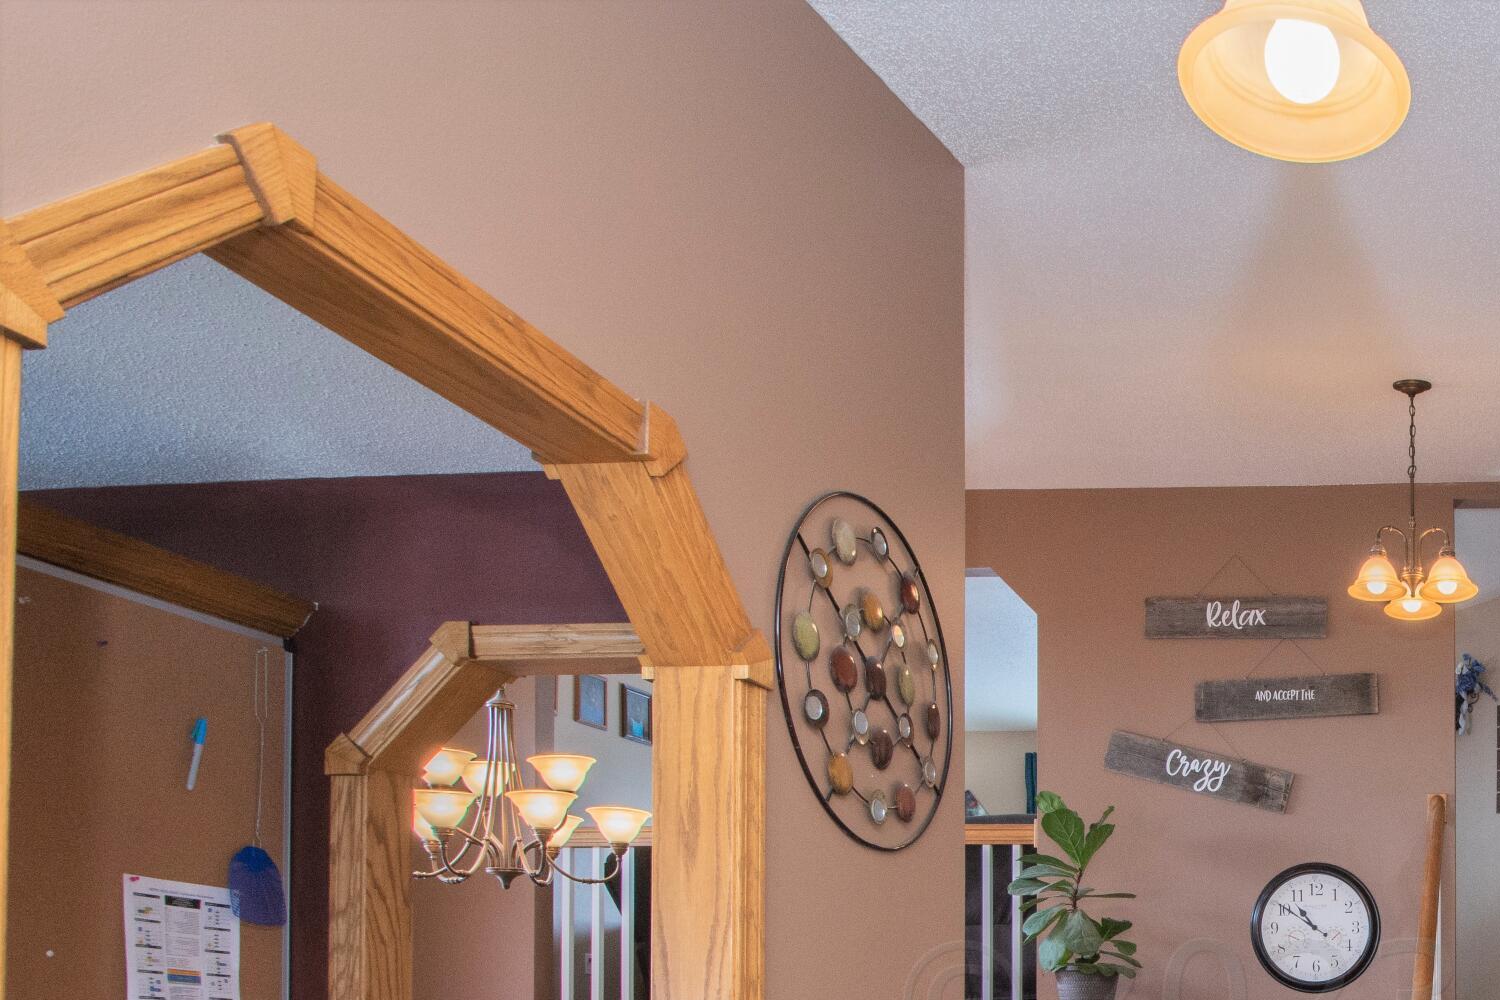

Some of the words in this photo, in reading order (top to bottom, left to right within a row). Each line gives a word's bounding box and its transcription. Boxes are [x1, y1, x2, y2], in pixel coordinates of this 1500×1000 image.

[1206, 600, 1266, 629] Relax
[1255, 690, 1271, 702] AND
[1273, 690, 1300, 701] ACCEPT
[1301, 689, 1315, 701] THE
[1166, 749, 1230, 792] Crazy
[1292, 890, 1303, 902] 11
[1309, 883, 1324, 896] 12
[1279, 903, 1291, 916] 10
[1344, 901, 1353, 914] 2
[1270, 921, 1279, 934] 9
[1352, 921, 1360, 934] 3
[1345, 939, 1353, 951] 4
[1293, 955, 1301, 968] 7
[1312, 960, 1320, 973] 6
[1330, 955, 1339, 968] 5
